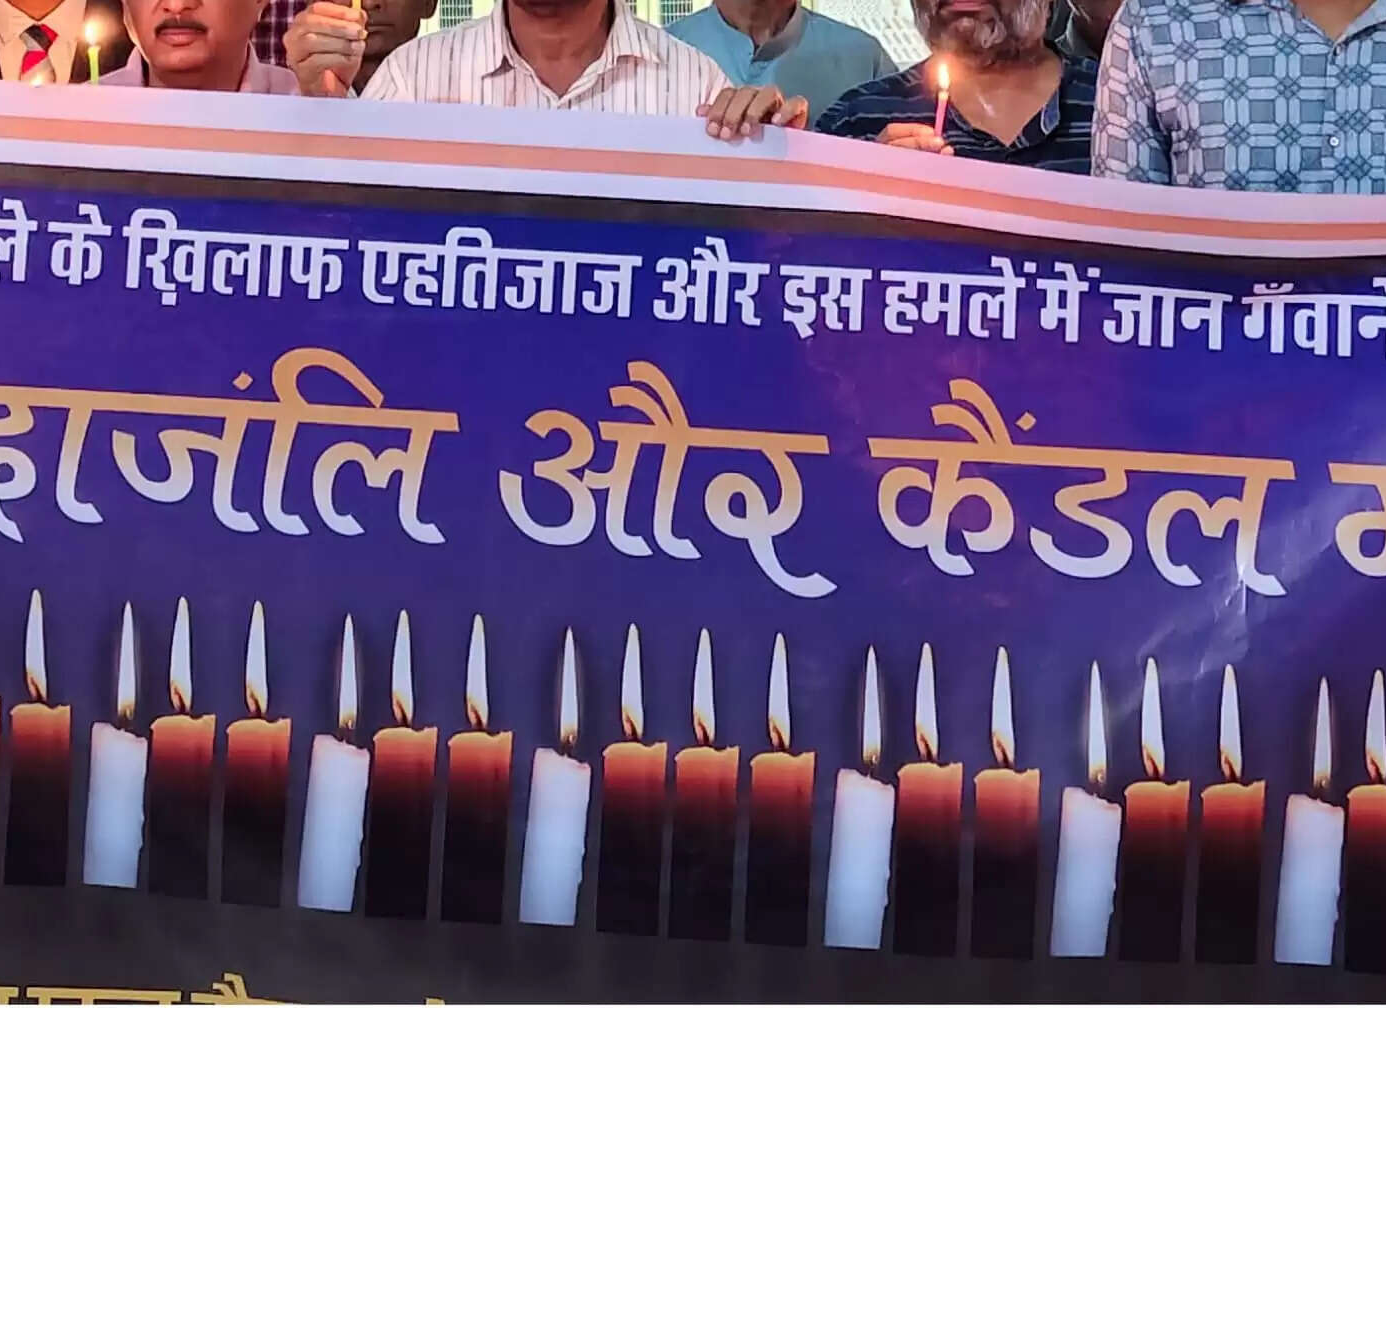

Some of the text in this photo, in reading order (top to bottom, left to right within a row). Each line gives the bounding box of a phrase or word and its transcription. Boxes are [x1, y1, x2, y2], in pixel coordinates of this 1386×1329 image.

[49, 203, 112, 286] के
[358, 227, 643, 319] एहतिजाज
[652, 236, 771, 329] और
[779, 263, 872, 339] इस
[881, 256, 1037, 341] हमलें
[1036, 261, 1102, 345] में
[1101, 281, 1232, 352] जान
[498, 359, 839, 599] और
[867, 377, 1297, 598] कैंडल
